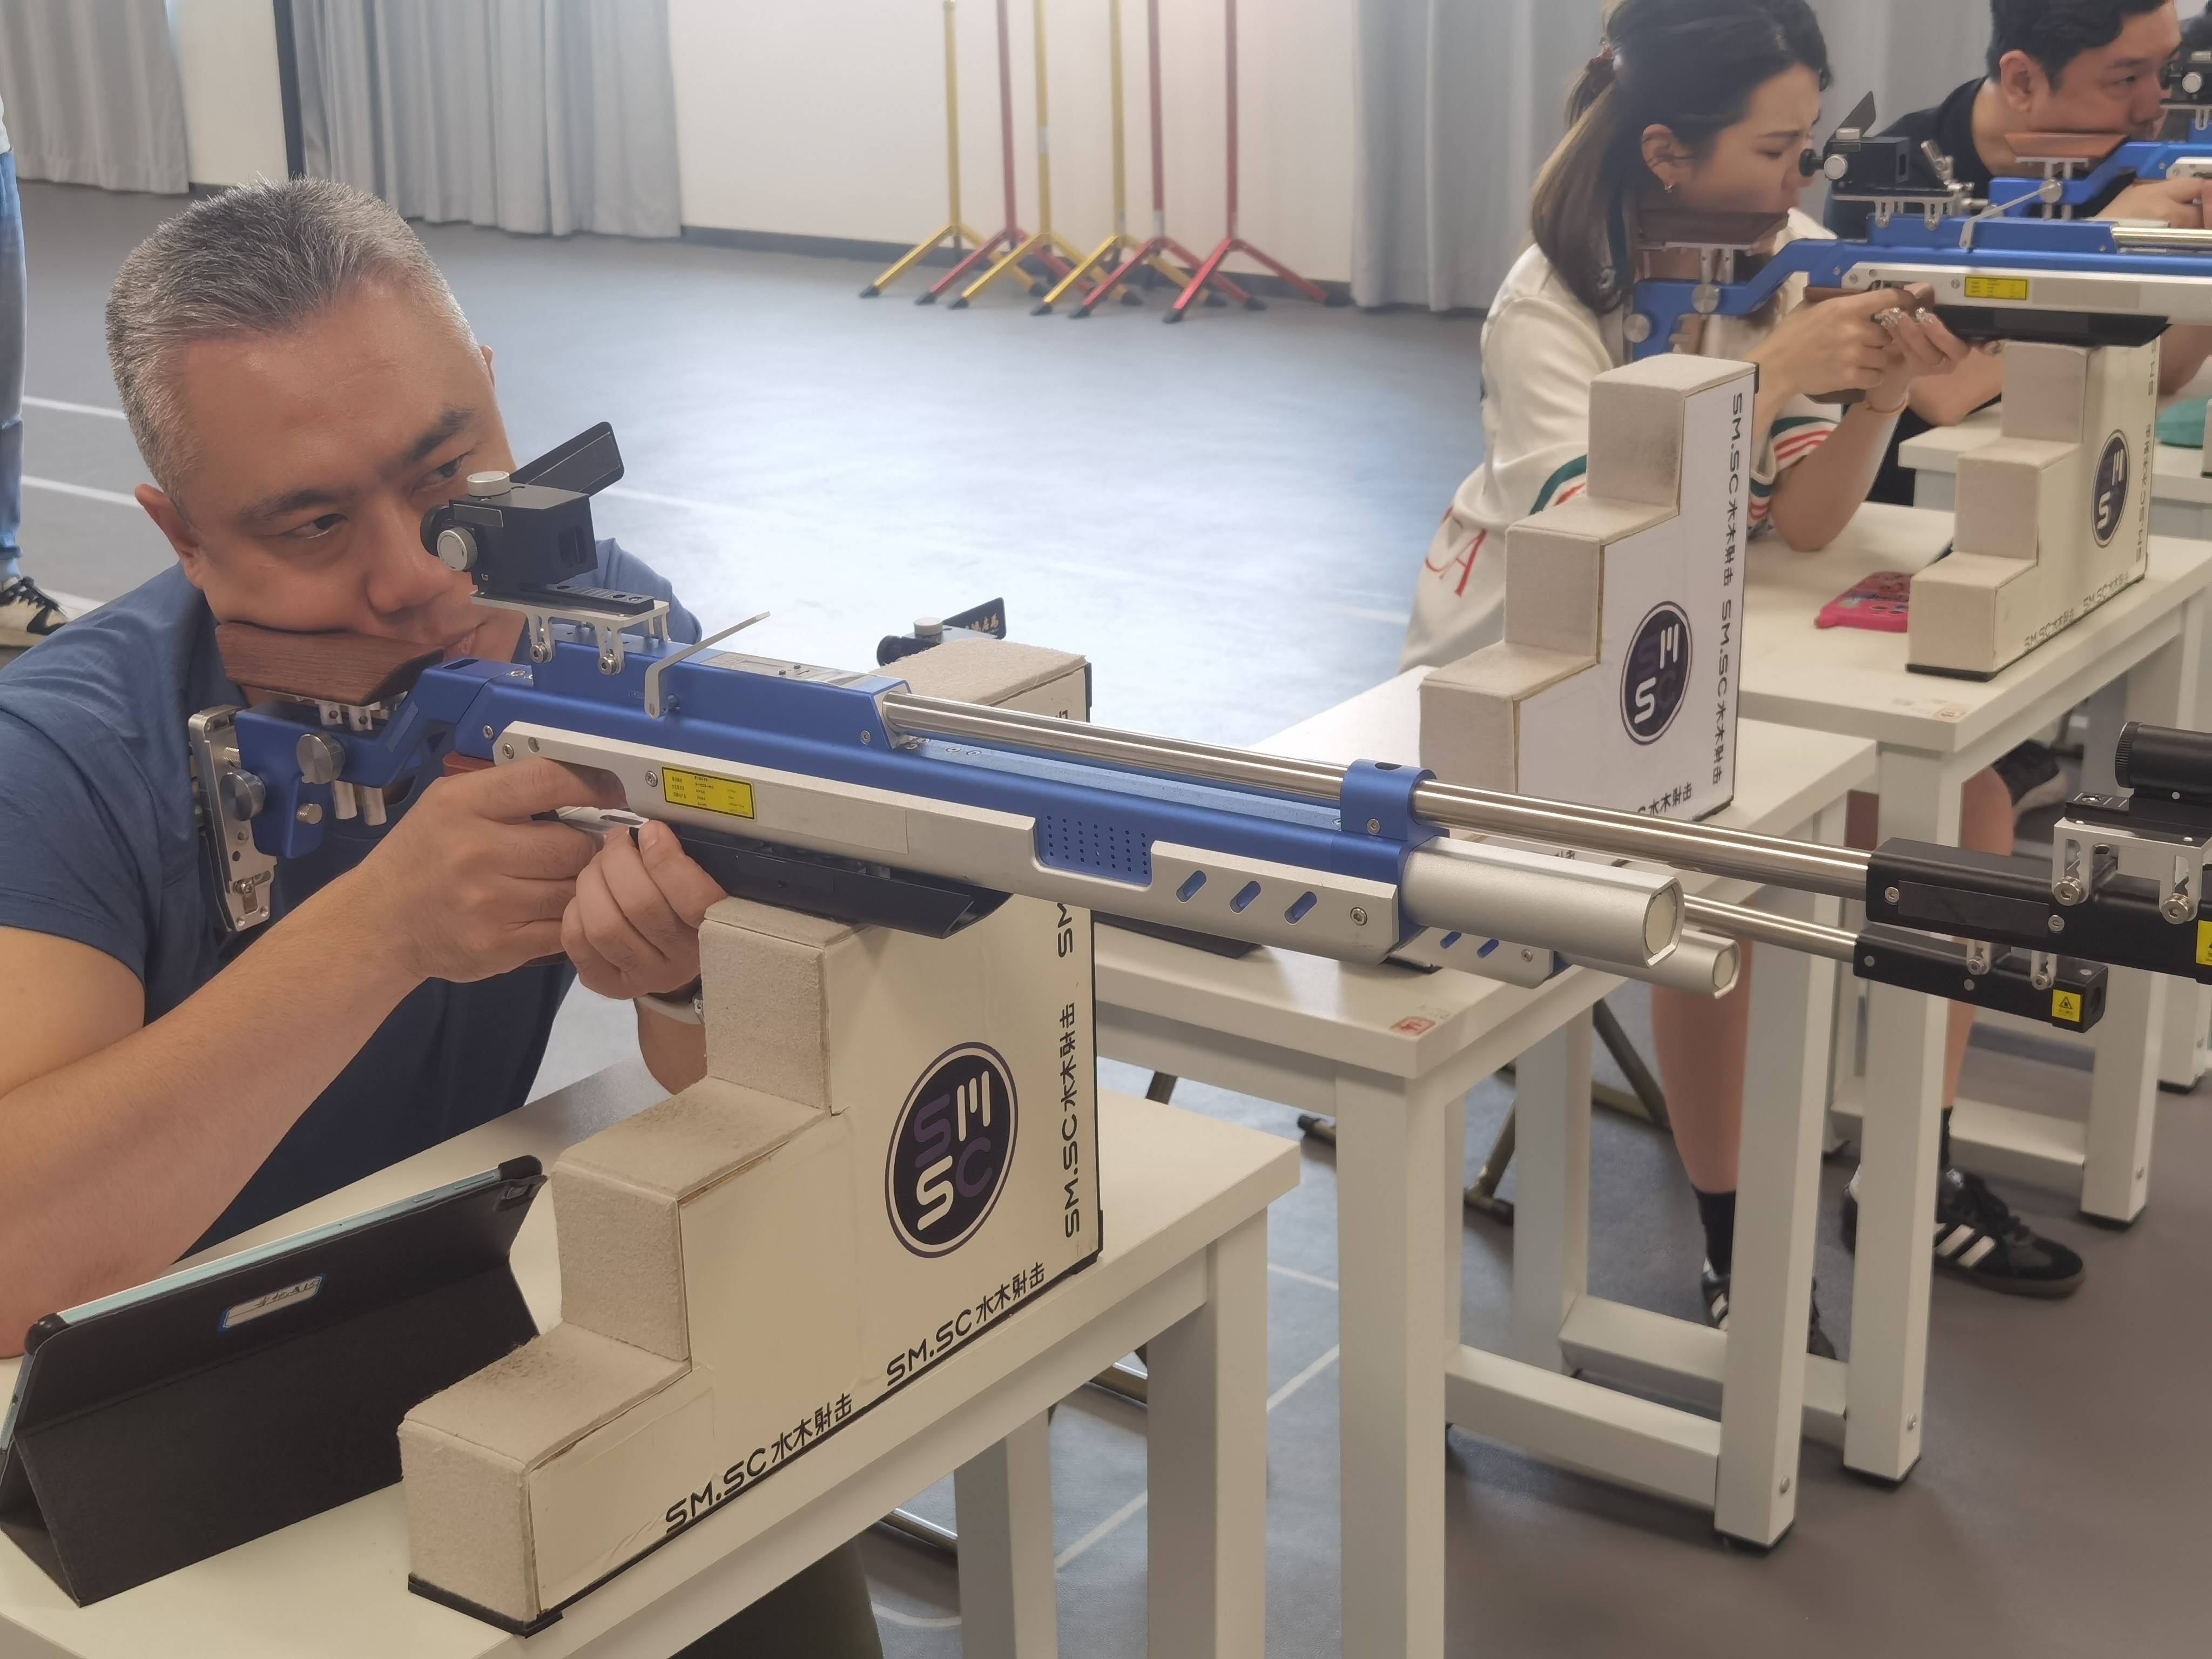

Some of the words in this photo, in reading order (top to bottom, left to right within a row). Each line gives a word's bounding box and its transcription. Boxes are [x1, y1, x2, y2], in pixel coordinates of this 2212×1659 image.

[1729, 393, 1742, 495] SM.SC
[1723, 497, 1738, 586] 水木射击
[1717, 599, 1731, 698] SM.SC
[1712, 700, 1727, 786] 水木射击
[1060, 1002, 1078, 1107] 水木射击
[1062, 1118, 1080, 1238] SM.SC
[886, 1309, 973, 1386] SM.SC
[975, 1262, 1046, 1324] 水木射击
[665, 1447, 766, 1534] SM.SC
[771, 1392, 853, 1463] 水木射击
